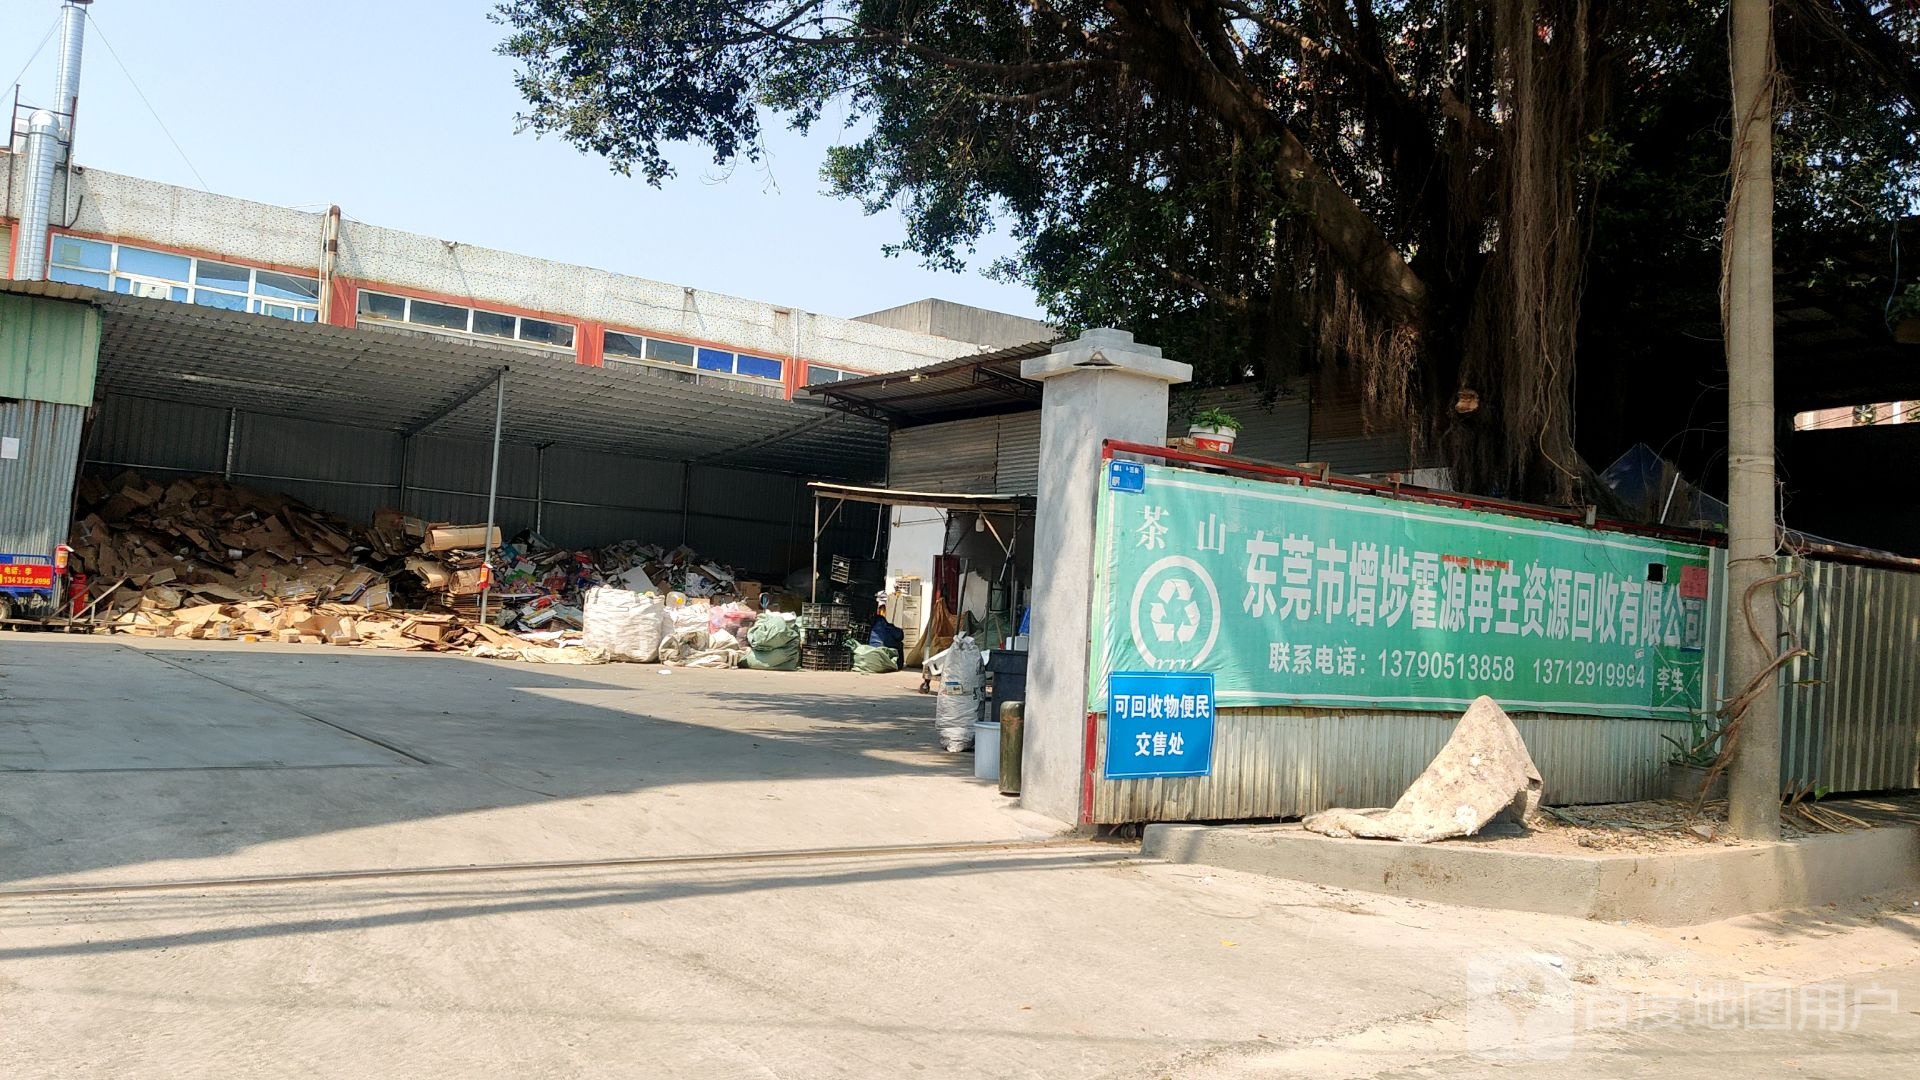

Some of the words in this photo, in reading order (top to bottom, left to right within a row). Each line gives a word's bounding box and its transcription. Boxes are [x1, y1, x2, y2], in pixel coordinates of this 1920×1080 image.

[1378, 649, 1514, 682] 13790513858
[1533, 657, 1645, 688] 13712919994
[1113, 694, 1210, 719] 可回收物便民
[1134, 731, 1185, 757] 交售处
